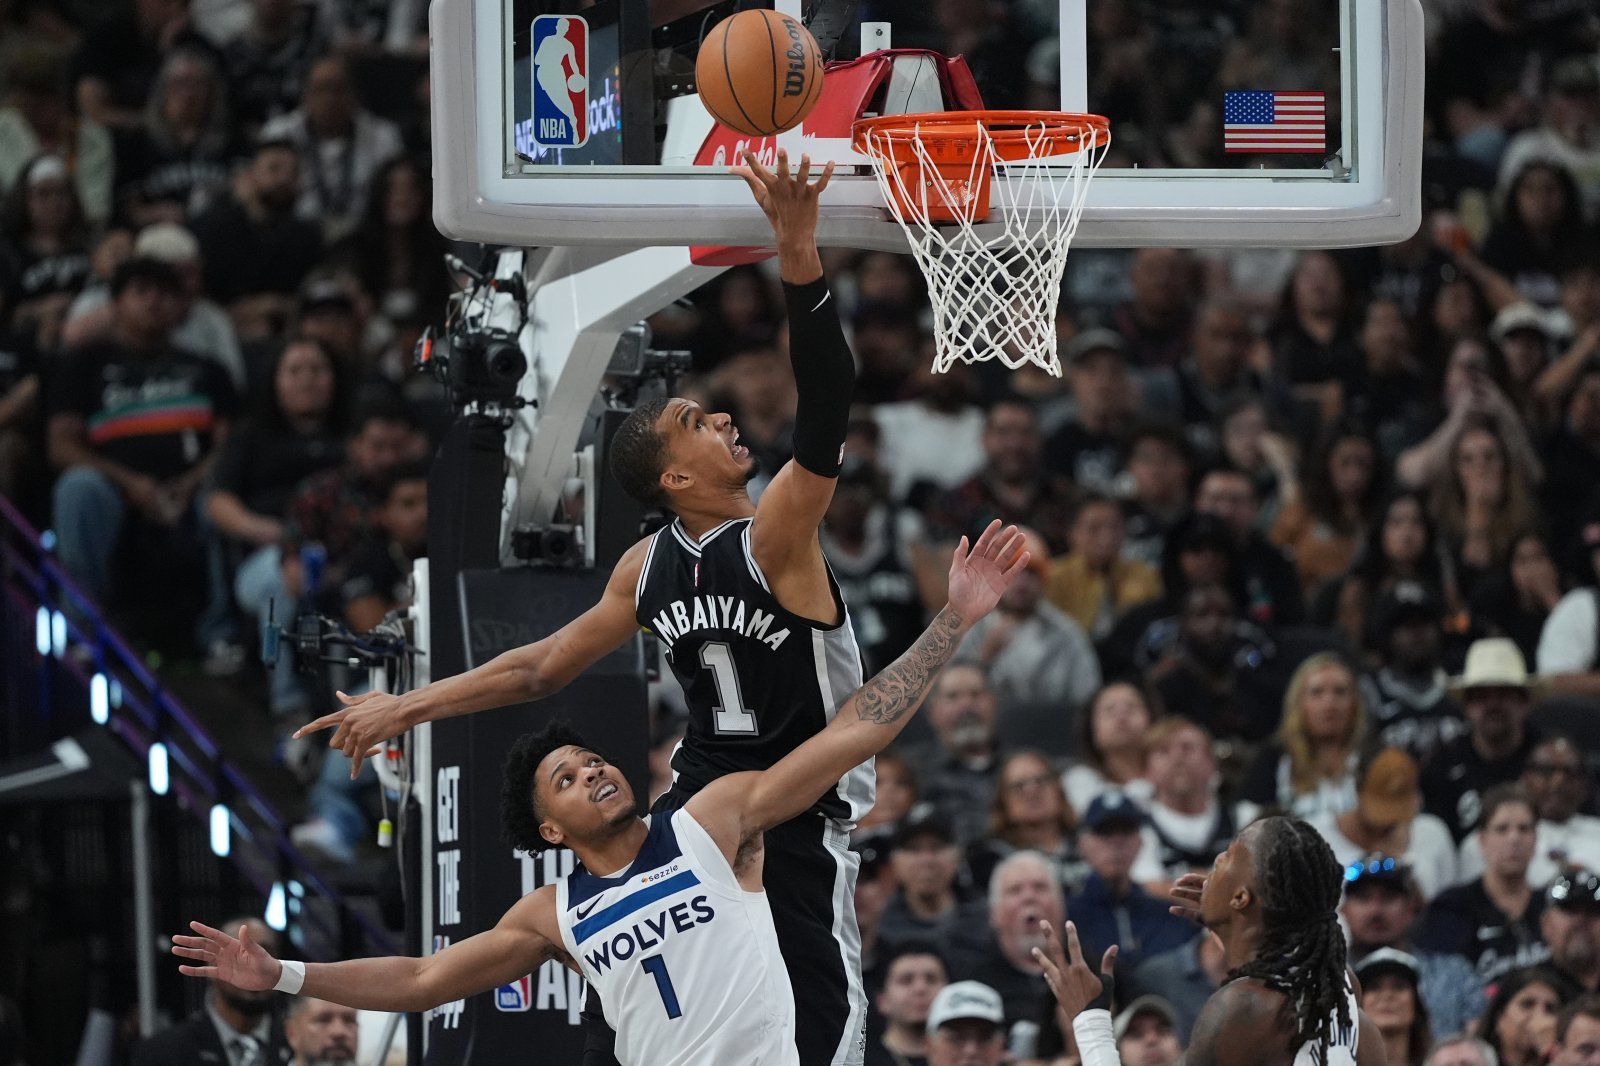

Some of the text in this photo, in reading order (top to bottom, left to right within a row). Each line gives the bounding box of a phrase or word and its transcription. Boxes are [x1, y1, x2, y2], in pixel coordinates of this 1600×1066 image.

[782, 19, 806, 98] Wilson
[540, 118, 567, 138] NBA
[698, 640, 759, 736] 1
[437, 766, 460, 844] GET
[437, 849, 461, 926] THE
[648, 864, 679, 882] sezzle
[584, 895, 715, 977] WOLVES
[640, 953, 682, 1020] 1
